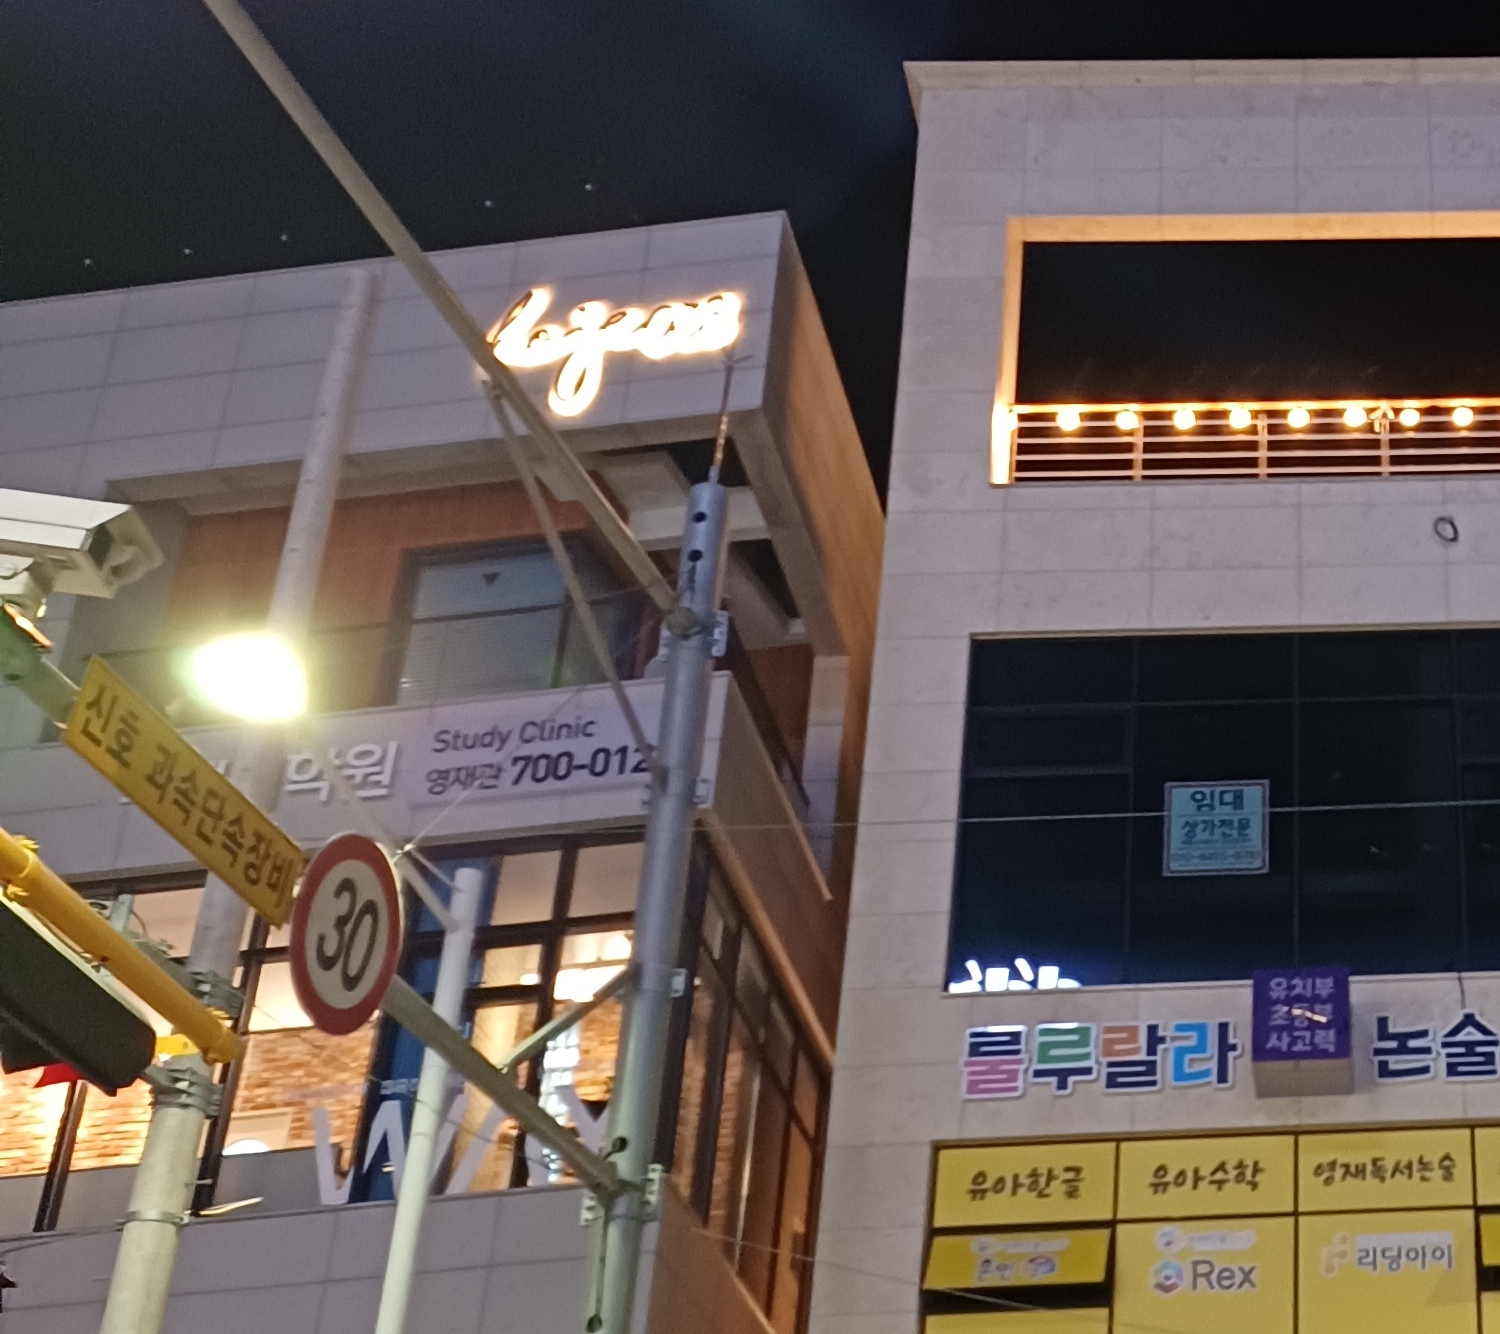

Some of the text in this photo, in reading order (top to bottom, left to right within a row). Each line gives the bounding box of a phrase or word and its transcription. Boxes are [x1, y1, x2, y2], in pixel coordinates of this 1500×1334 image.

[432, 716, 598, 755] Study Clinic
[509, 744, 652, 788] 700-012
[78, 685, 296, 909] 신호 과속단속장비
[1190, 788, 1244, 812] 임대
[315, 876, 379, 993] 30
[1268, 977, 1336, 1000] 유치부
[1265, 1028, 1337, 1052] 사고력
[963, 1019, 1240, 1097] 룰루랄라
[967, 1165, 1087, 1200] 유아한글
[1148, 1158, 1266, 1194] 유아수학
[1312, 1152, 1457, 1187] 영재독서논술
[1191, 1259, 1257, 1291] Rex
[1357, 1244, 1454, 1273] 리딩아이
